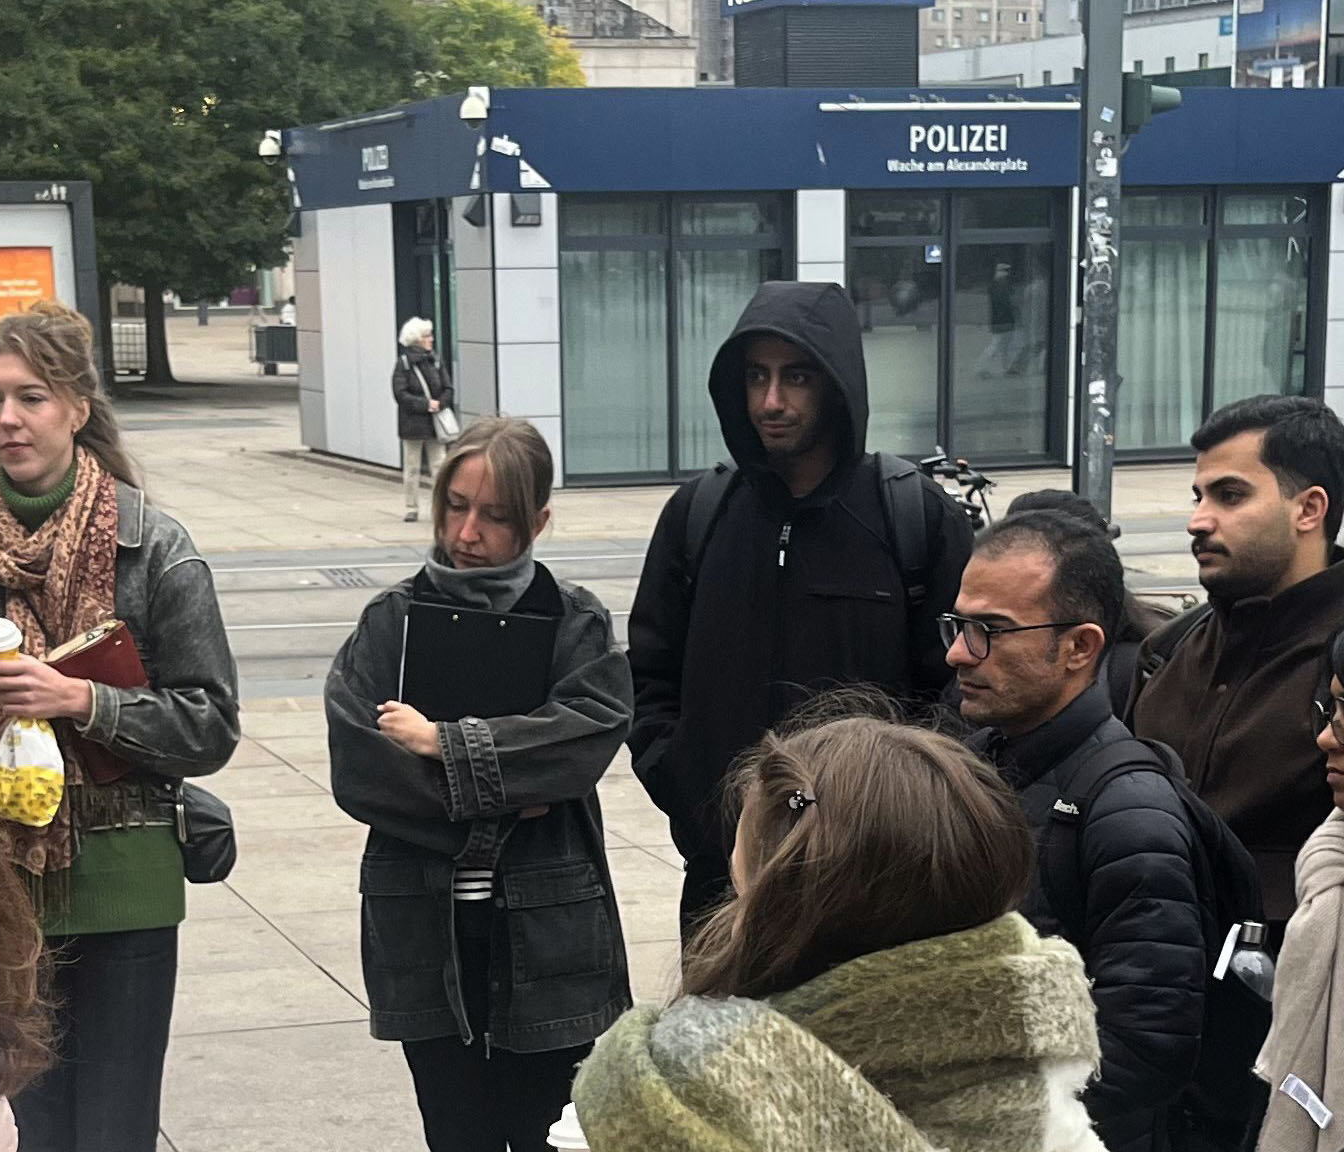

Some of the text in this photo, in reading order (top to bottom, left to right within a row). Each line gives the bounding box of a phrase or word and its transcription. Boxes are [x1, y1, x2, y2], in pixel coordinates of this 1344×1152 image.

[909, 125, 1008, 153] POLIZEI
[362, 145, 389, 172] POLIZEI
[887, 157, 1029, 174] Wache am Alexanderplatz
